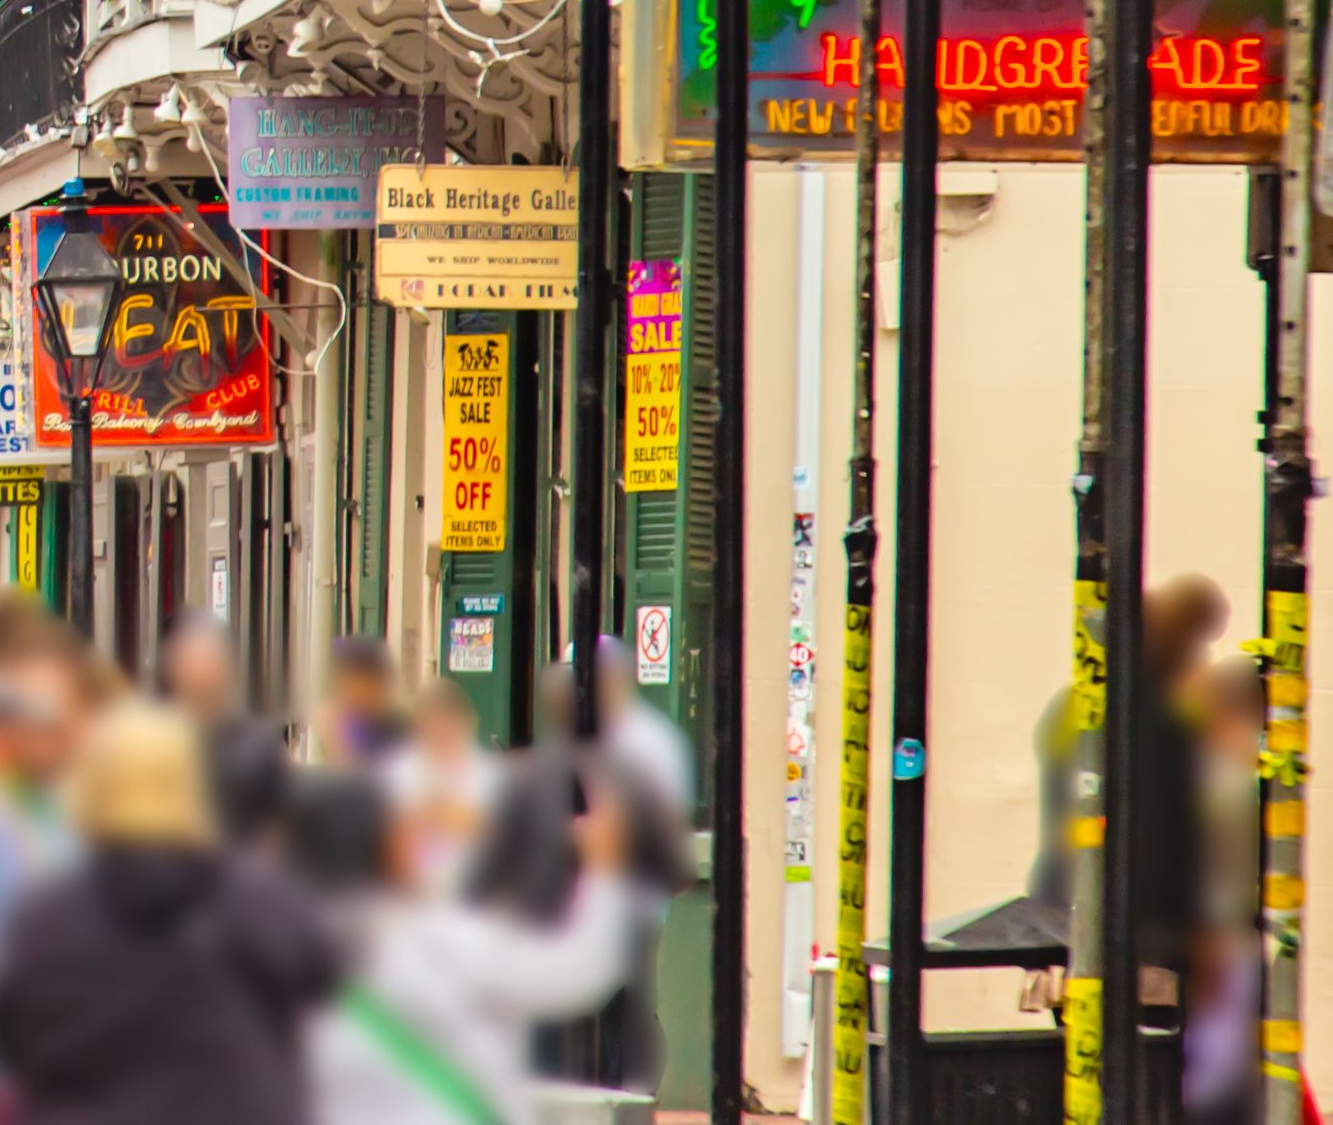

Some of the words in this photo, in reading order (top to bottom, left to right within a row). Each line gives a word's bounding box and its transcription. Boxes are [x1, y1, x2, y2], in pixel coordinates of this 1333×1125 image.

[766, 98, 833, 135] NEW
[995, 99, 1077, 138] MOST
[236, 186, 291, 203] CUSTOM
[296, 185, 359, 203] FRAMING
[387, 187, 436, 210] Black
[446, 187, 521, 217] Heritage
[531, 189, 577, 211] Galle
[261, 210, 281, 221] WE
[292, 210, 323, 221] SHIP
[134, 234, 164, 251] 711
[114, 254, 222, 284] URBON
[427, 256, 446, 265] WE
[453, 256, 481, 265] SHIP
[487, 256, 561, 266] WORLDWIDE
[437, 283, 511, 298] KODAK
[630, 320, 682, 353] SALE
[449, 376, 474, 398] JAZZ
[477, 376, 502, 397] FEST
[632, 364, 653, 395] 10%
[82, 386, 148, 417] RILL
[206, 374, 260, 409] CLUB
[91, 411, 164, 434] Balcony
[173, 409, 259, 434] Courtyard
[460, 402, 490, 424] SALE
[638, 405, 676, 437] 50%
[449, 436, 501, 473] 50%
[629, 471, 657, 484] ITEMS
[455, 481, 492, 511] OFF
[451, 520, 497, 533] SELECTED
[446, 535, 474, 547] ITEMS
[477, 535, 501, 548] ONLY
[454, 621, 491, 636] BEADS
